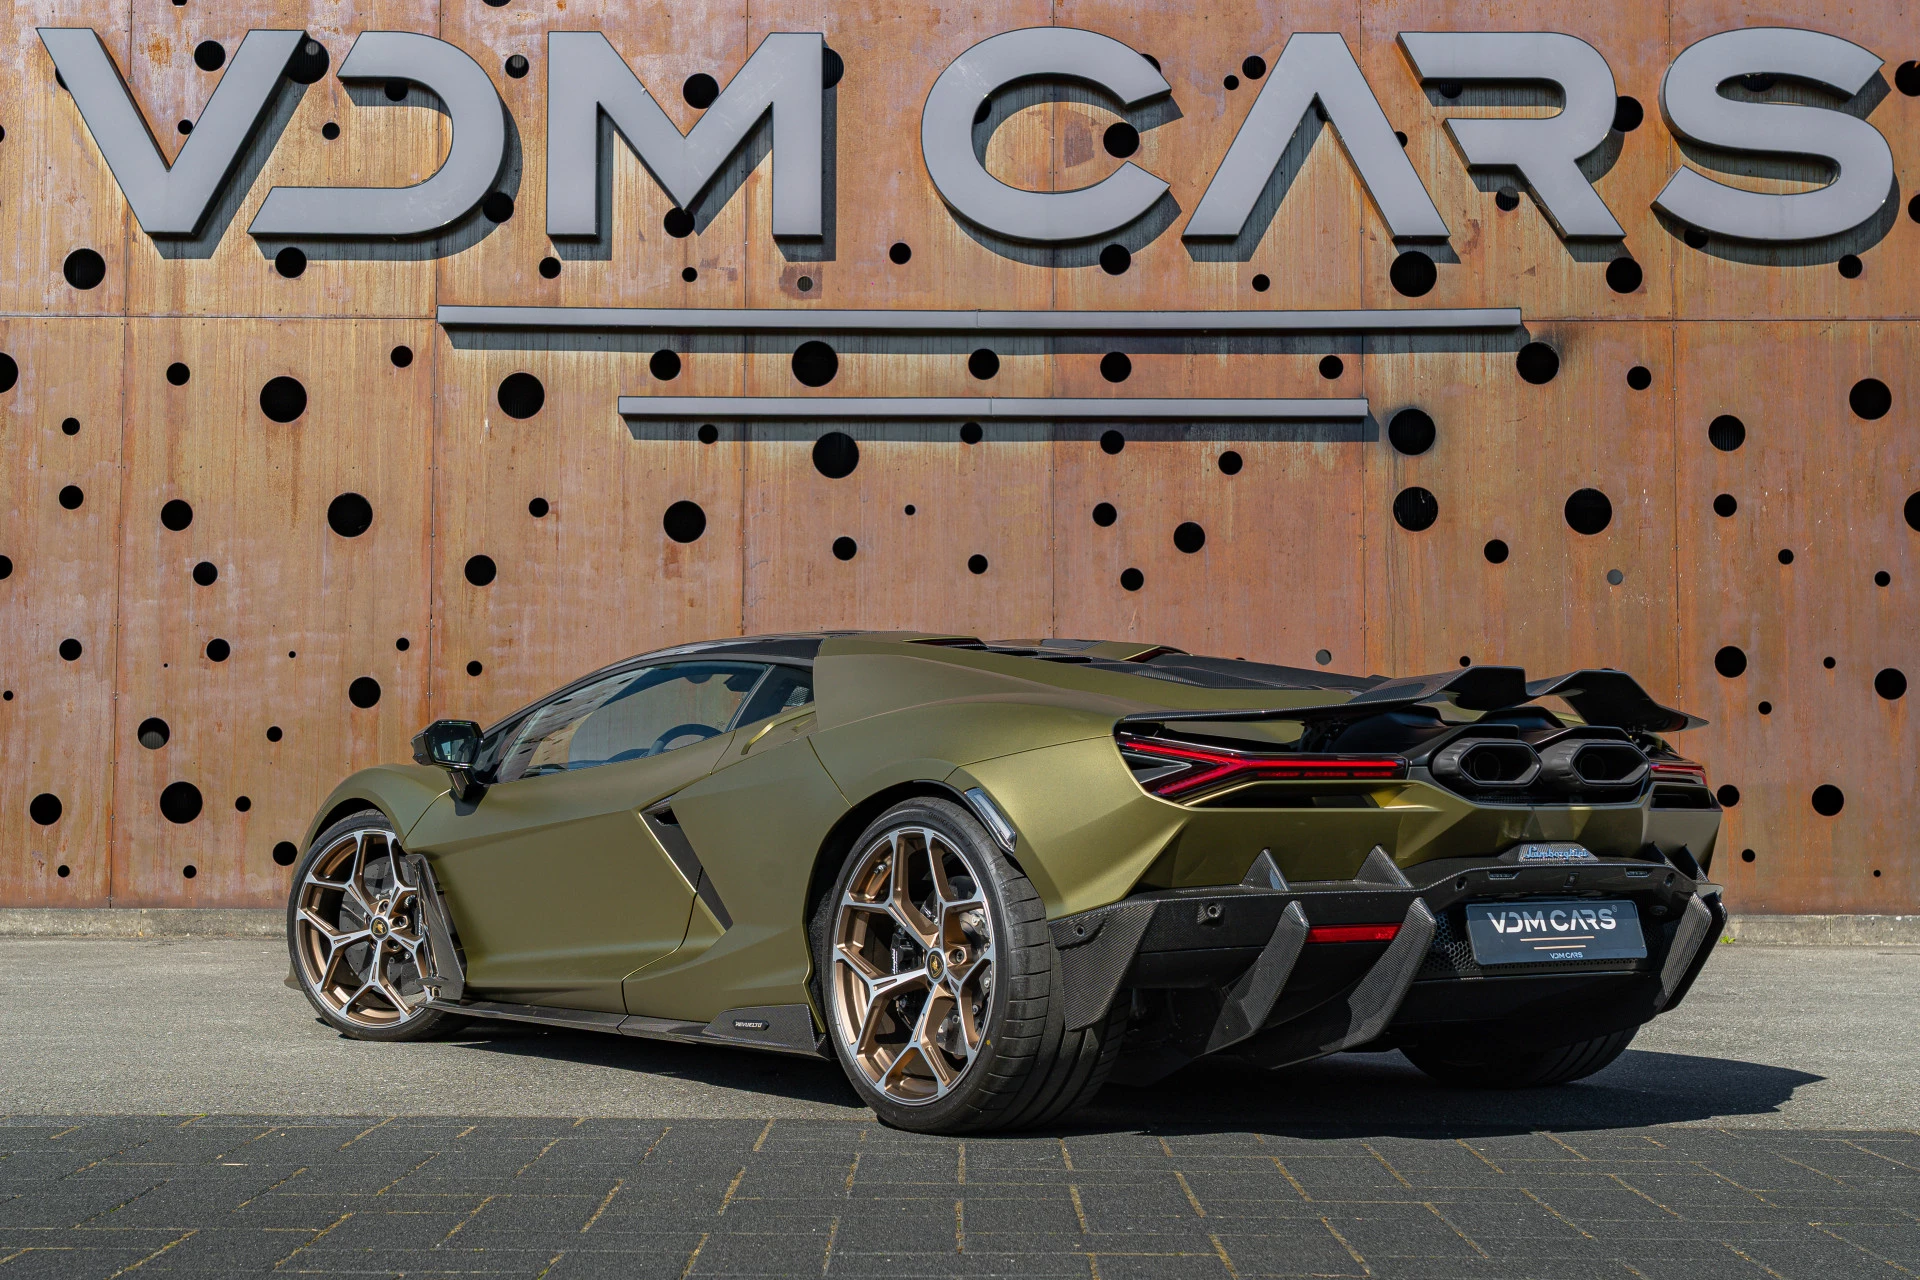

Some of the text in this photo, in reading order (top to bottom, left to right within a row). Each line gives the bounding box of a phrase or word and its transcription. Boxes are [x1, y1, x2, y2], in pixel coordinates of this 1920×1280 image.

[36, 26, 1896, 241] VDM CARS
[1524, 846, 1589, 860] Lamborghini
[1487, 909, 1616, 933] VDM CARS
